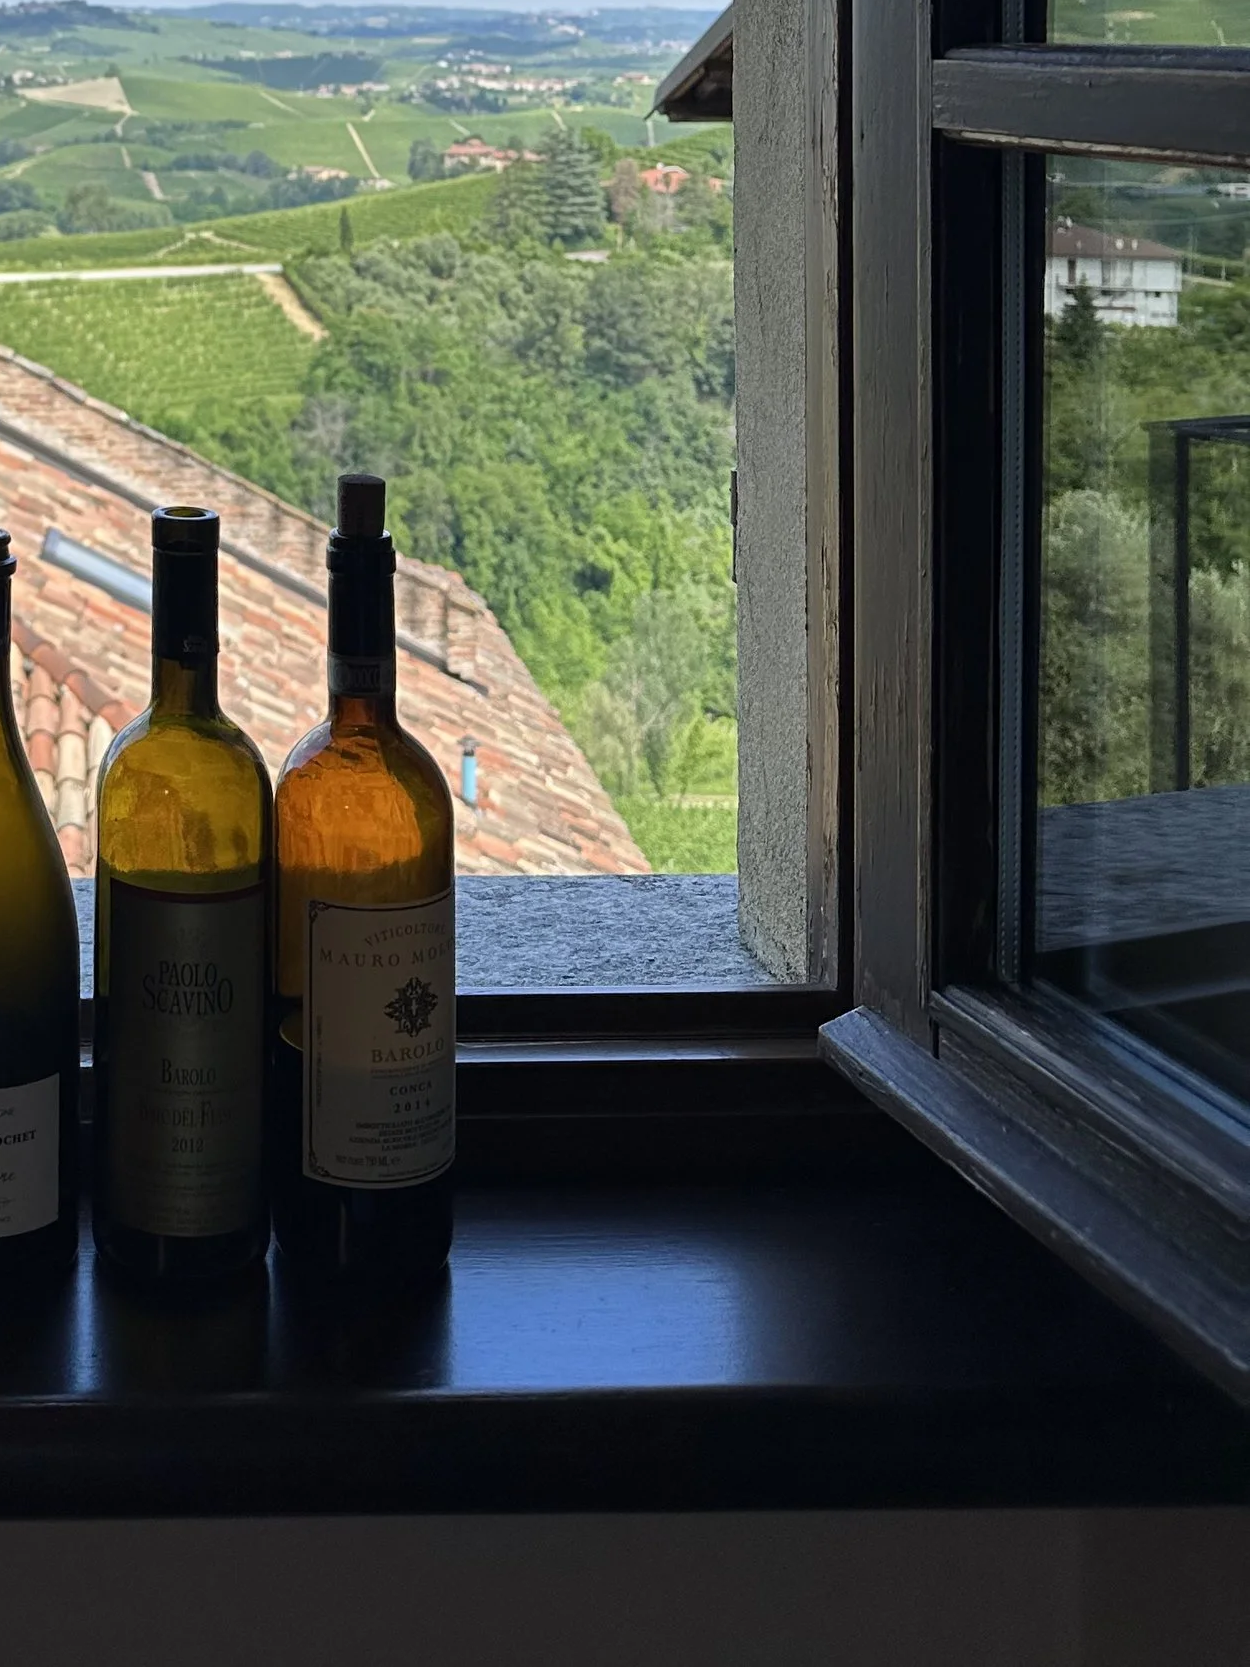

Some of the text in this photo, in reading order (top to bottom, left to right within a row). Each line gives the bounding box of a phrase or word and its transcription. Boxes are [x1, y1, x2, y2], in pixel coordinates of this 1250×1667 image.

[320, 946, 400, 968] MAURO
[158, 960, 217, 987] PAOLO
[143, 974, 234, 1015] SCAVINO
[371, 1037, 444, 1064] BAROLO
[161, 1058, 217, 1086] BAROLO
[390, 1080, 432, 1097] CONCA
[171, 1136, 205, 1153] 2012
